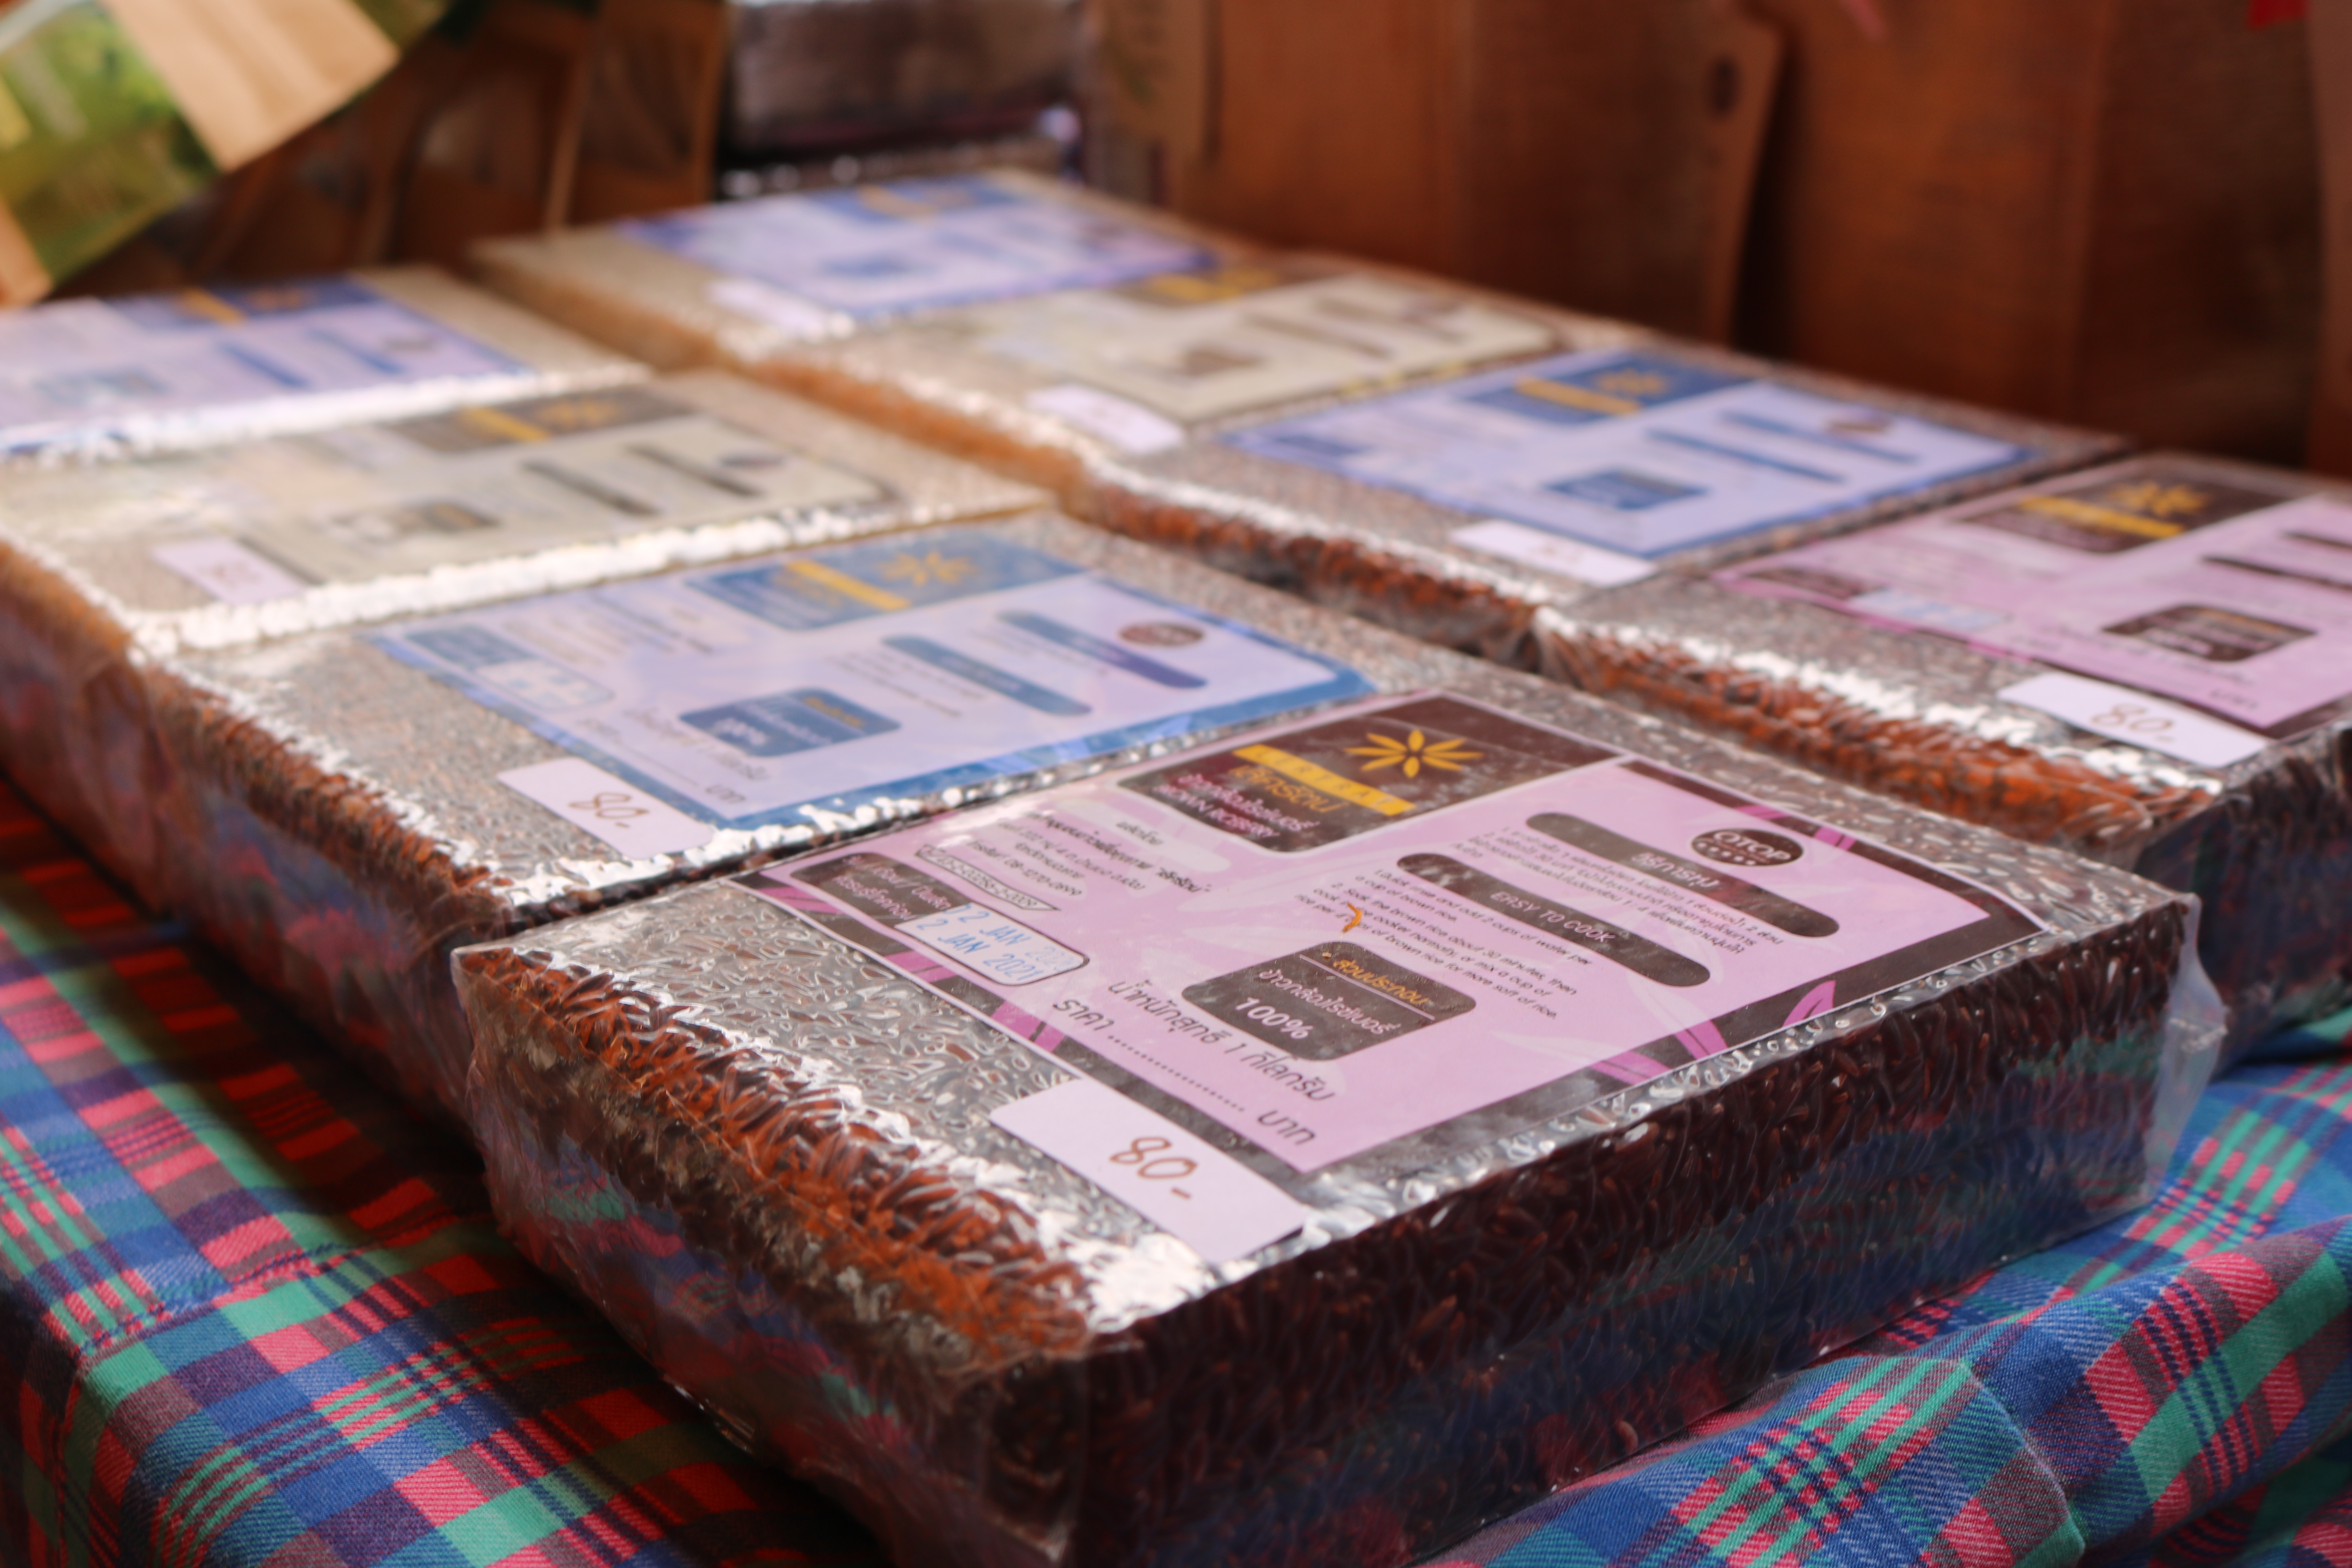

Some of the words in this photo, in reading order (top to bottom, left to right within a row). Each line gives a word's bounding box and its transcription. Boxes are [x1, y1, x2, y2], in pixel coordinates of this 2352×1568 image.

[1713, 831, 1791, 860] OTOP
[980, 926, 1029, 945] JAN
[1490, 891, 1540, 912] EASY
[1539, 909, 1567, 923] TO
[1563, 920, 1615, 943] COOK
[938, 934, 990, 954] JAN
[983, 953, 1044, 980] 2021
[1536, 940, 1567, 955] water
[1236, 997, 1310, 1038] 100%
[1051, 1000, 1114, 1030] ราคา
[1258, 1111, 1315, 1143] บาท
